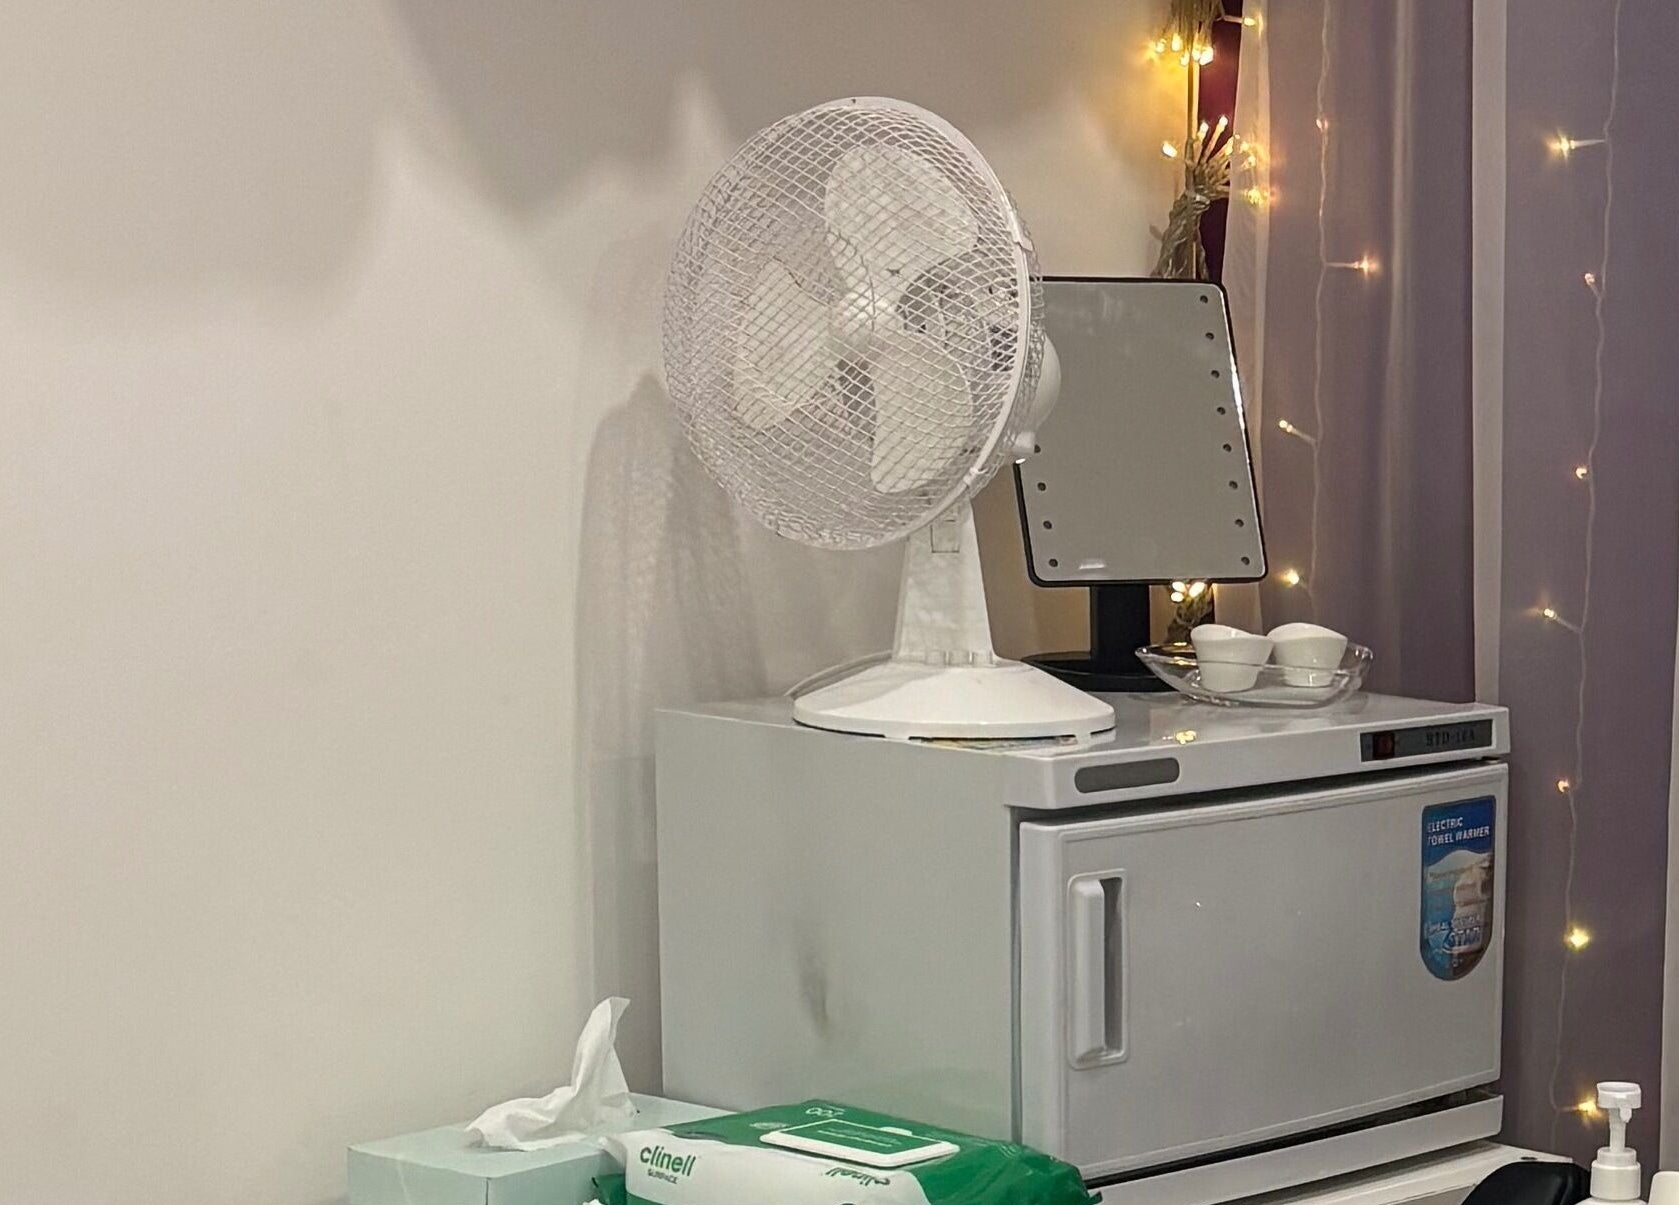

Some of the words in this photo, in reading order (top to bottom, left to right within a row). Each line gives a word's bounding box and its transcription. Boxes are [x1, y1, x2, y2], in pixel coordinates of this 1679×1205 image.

[1427, 817, 1463, 833] ELECTRIC
[1427, 833, 1454, 846] TOWEL
[1456, 826, 1490, 841] WARMER
[640, 1145, 697, 1177] clinell
